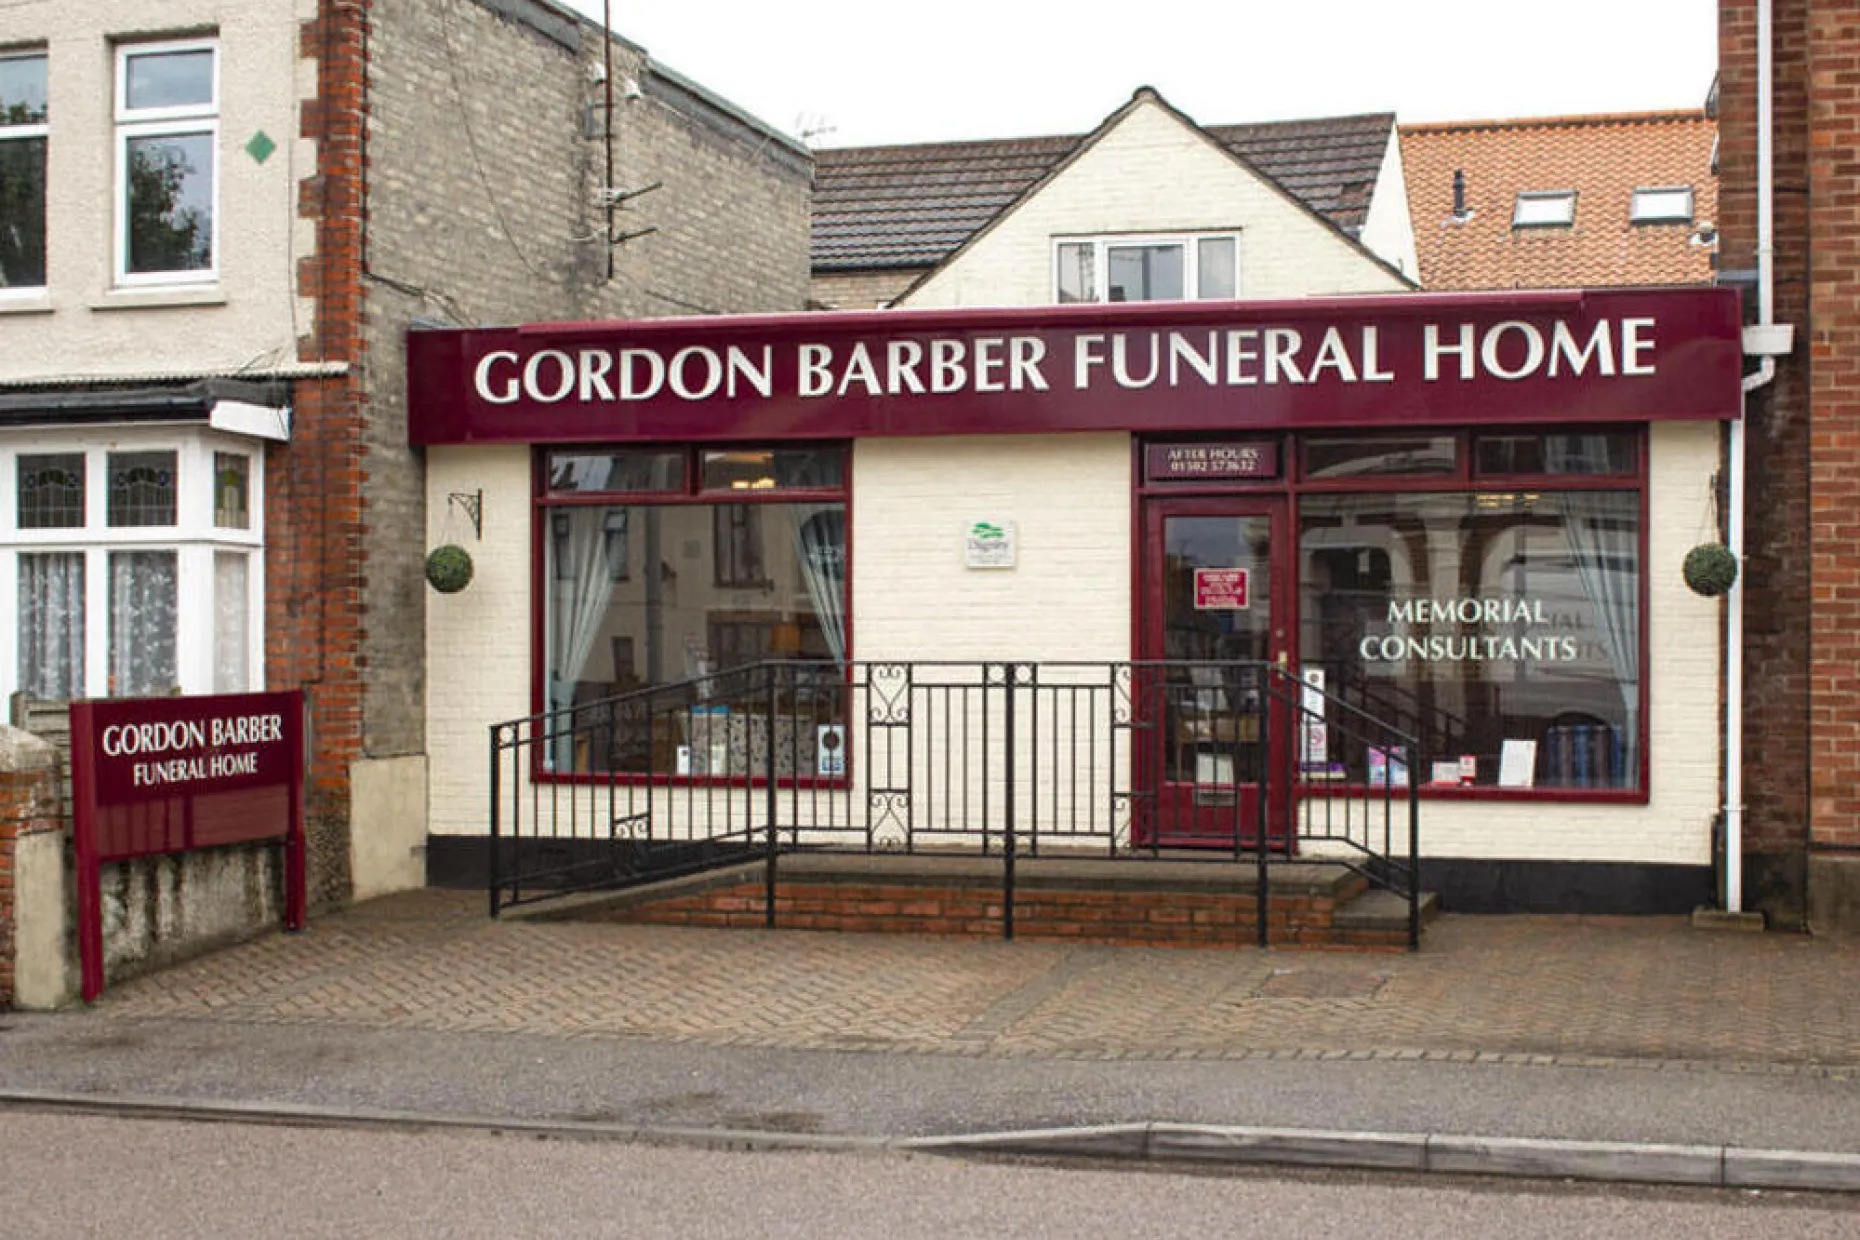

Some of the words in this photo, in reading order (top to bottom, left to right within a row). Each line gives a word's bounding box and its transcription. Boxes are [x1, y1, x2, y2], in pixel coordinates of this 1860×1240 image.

[474, 345, 773, 404] GORDON
[797, 336, 1050, 397] BARBER
[1074, 325, 1394, 390] FUNERAL
[1423, 317, 1656, 381] HOME
[1168, 448, 1206, 459] AFTER
[1210, 447, 1258, 459] HOURS
[1387, 599, 1549, 623] MEMORIAL
[1359, 635, 1578, 660] CONSULTANTS
[103, 719, 206, 756] GORDON
[211, 714, 283, 747] BARBER
[133, 756, 207, 787] FUNERAL
[210, 752, 258, 778] HOME
